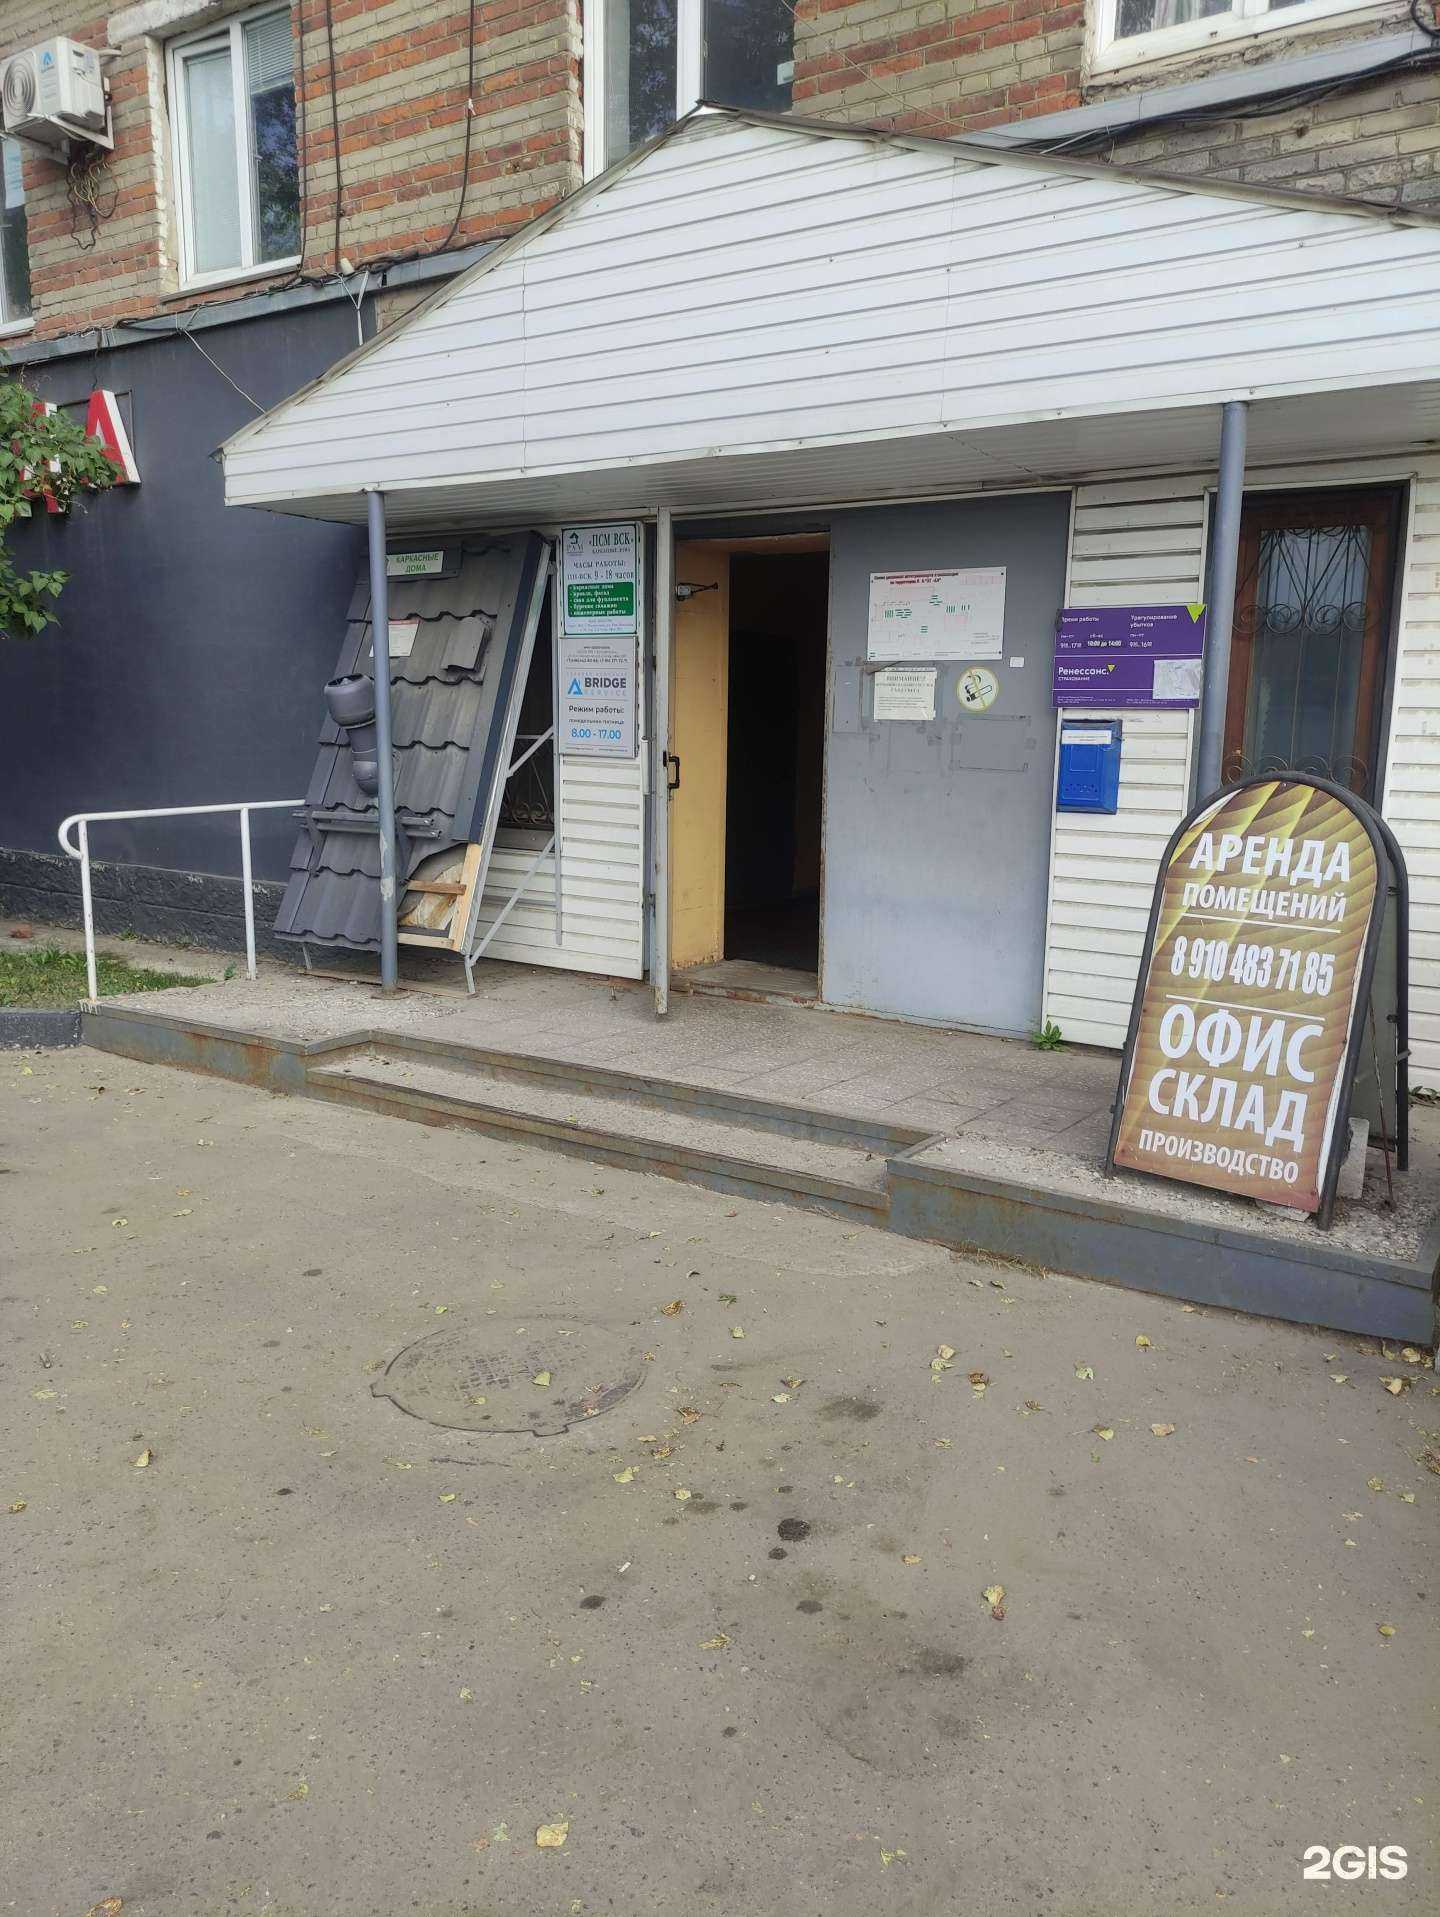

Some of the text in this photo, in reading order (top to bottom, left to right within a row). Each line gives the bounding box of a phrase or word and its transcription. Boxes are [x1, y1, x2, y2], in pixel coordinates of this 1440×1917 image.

[396, 552, 439, 563] КАРКАСНЫЕ
[405, 564, 426, 573] ДОМА
[605, 569, 613, 579] 18
[1131, 614, 1178, 622] Урегулирование
[584, 677, 627, 689] BRIDGE
[568, 704, 625, 715] Режим работы:
[571, 727, 592, 738] 8.00
[599, 729, 622, 740] 17.00
[1189, 832, 1350, 888] АРЕНДА
[1182, 882, 1347, 922] ПОМЕЩЕНИЙ
[1170, 935, 1336, 997] 8 910 483 71 85
[1159, 1003, 1324, 1083] ОФИС
[1148, 1068, 1308, 1153] СКЛАД
[1138, 1128, 1299, 1184] ПРОИЗВОДСТВО
